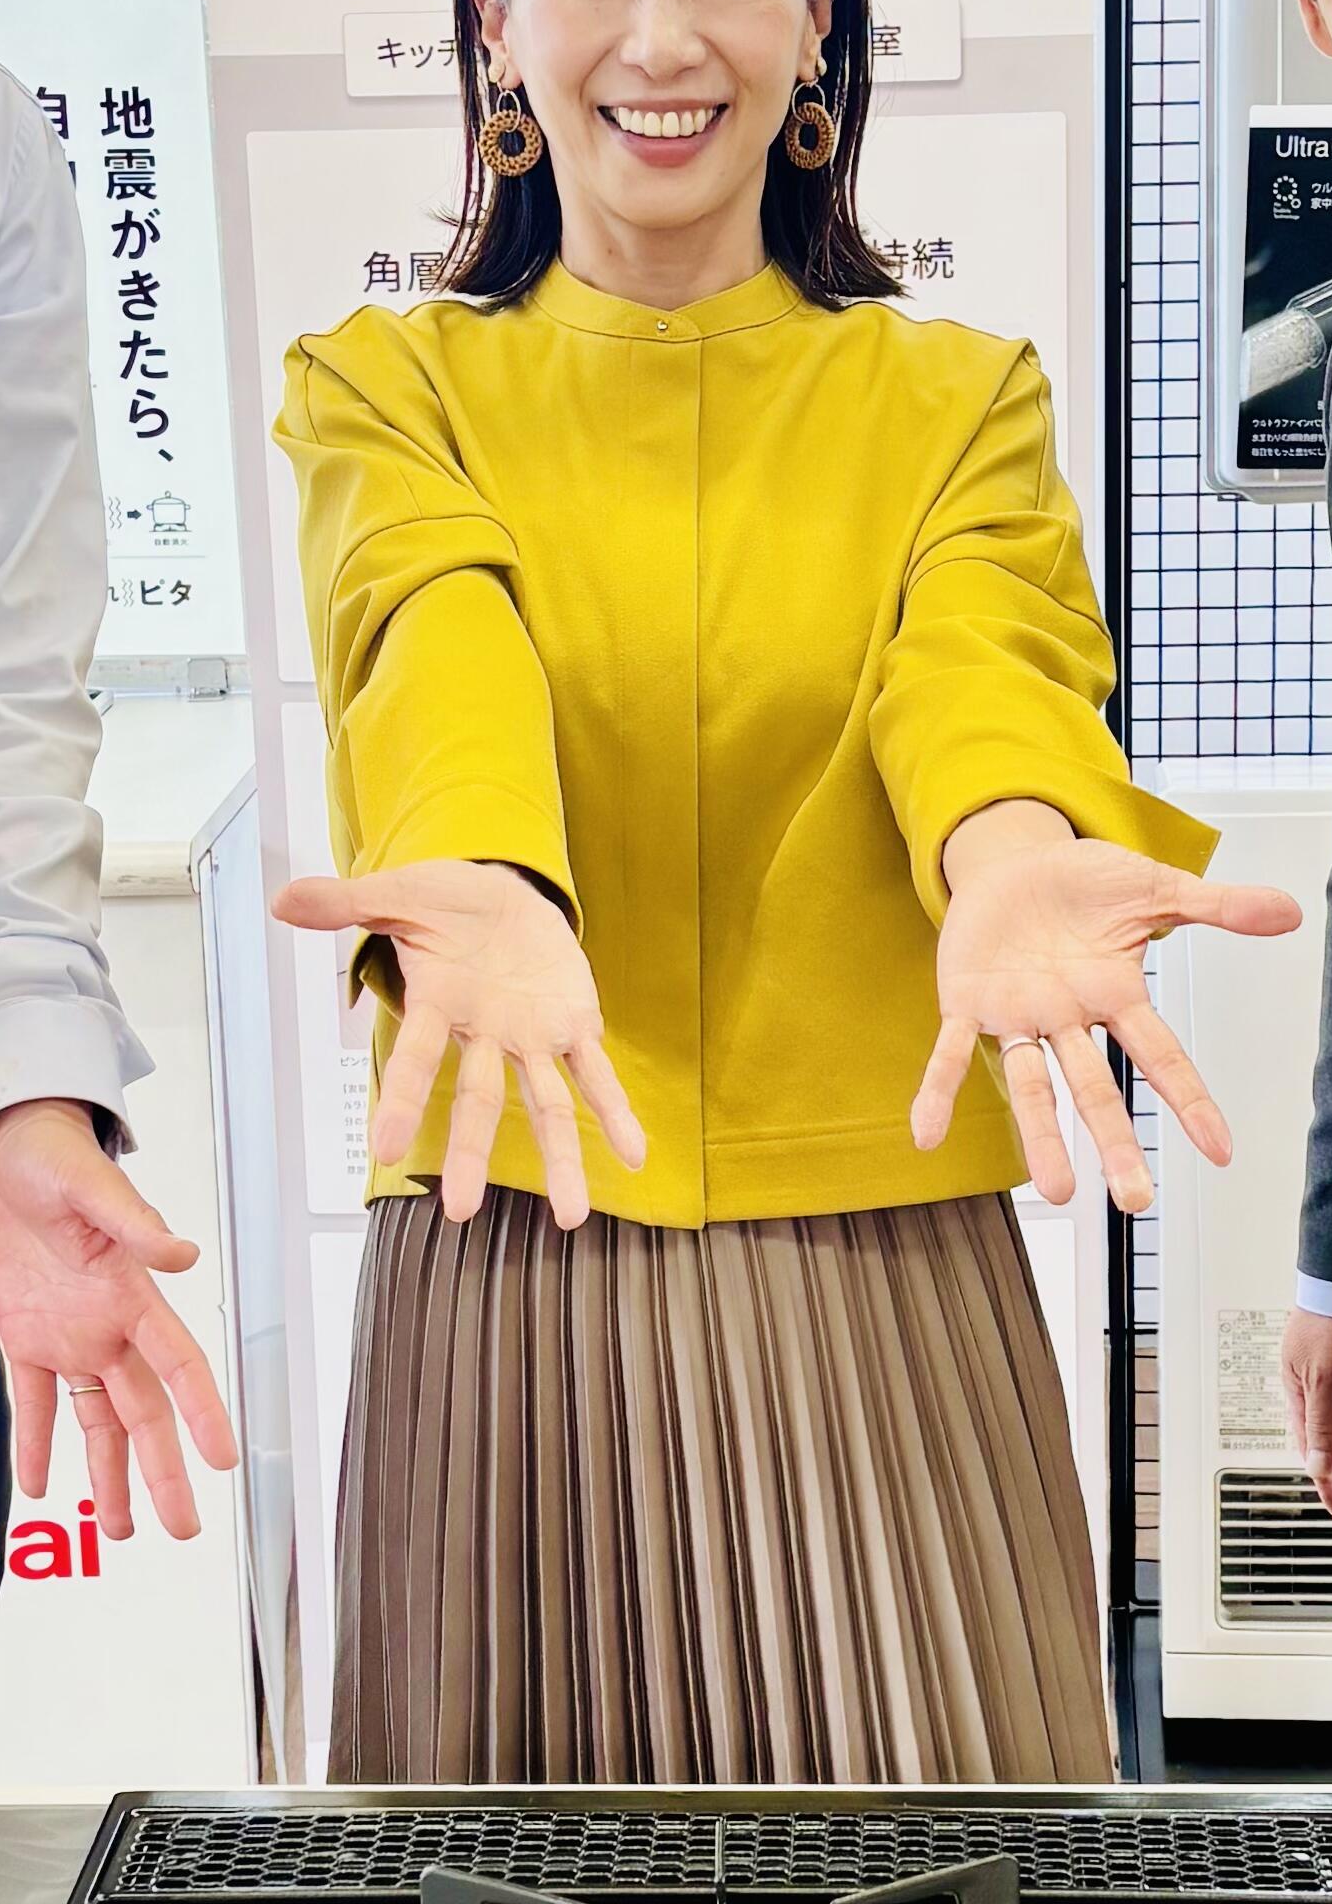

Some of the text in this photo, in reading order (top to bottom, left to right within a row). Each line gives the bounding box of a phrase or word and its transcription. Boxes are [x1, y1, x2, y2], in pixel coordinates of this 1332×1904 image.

[1275, 134, 1329, 158] Ultra
[100, 85, 174, 463] 地震がきたら、
[140, 578, 192, 606] ピタ
[9, 1499, 101, 1580] ai
